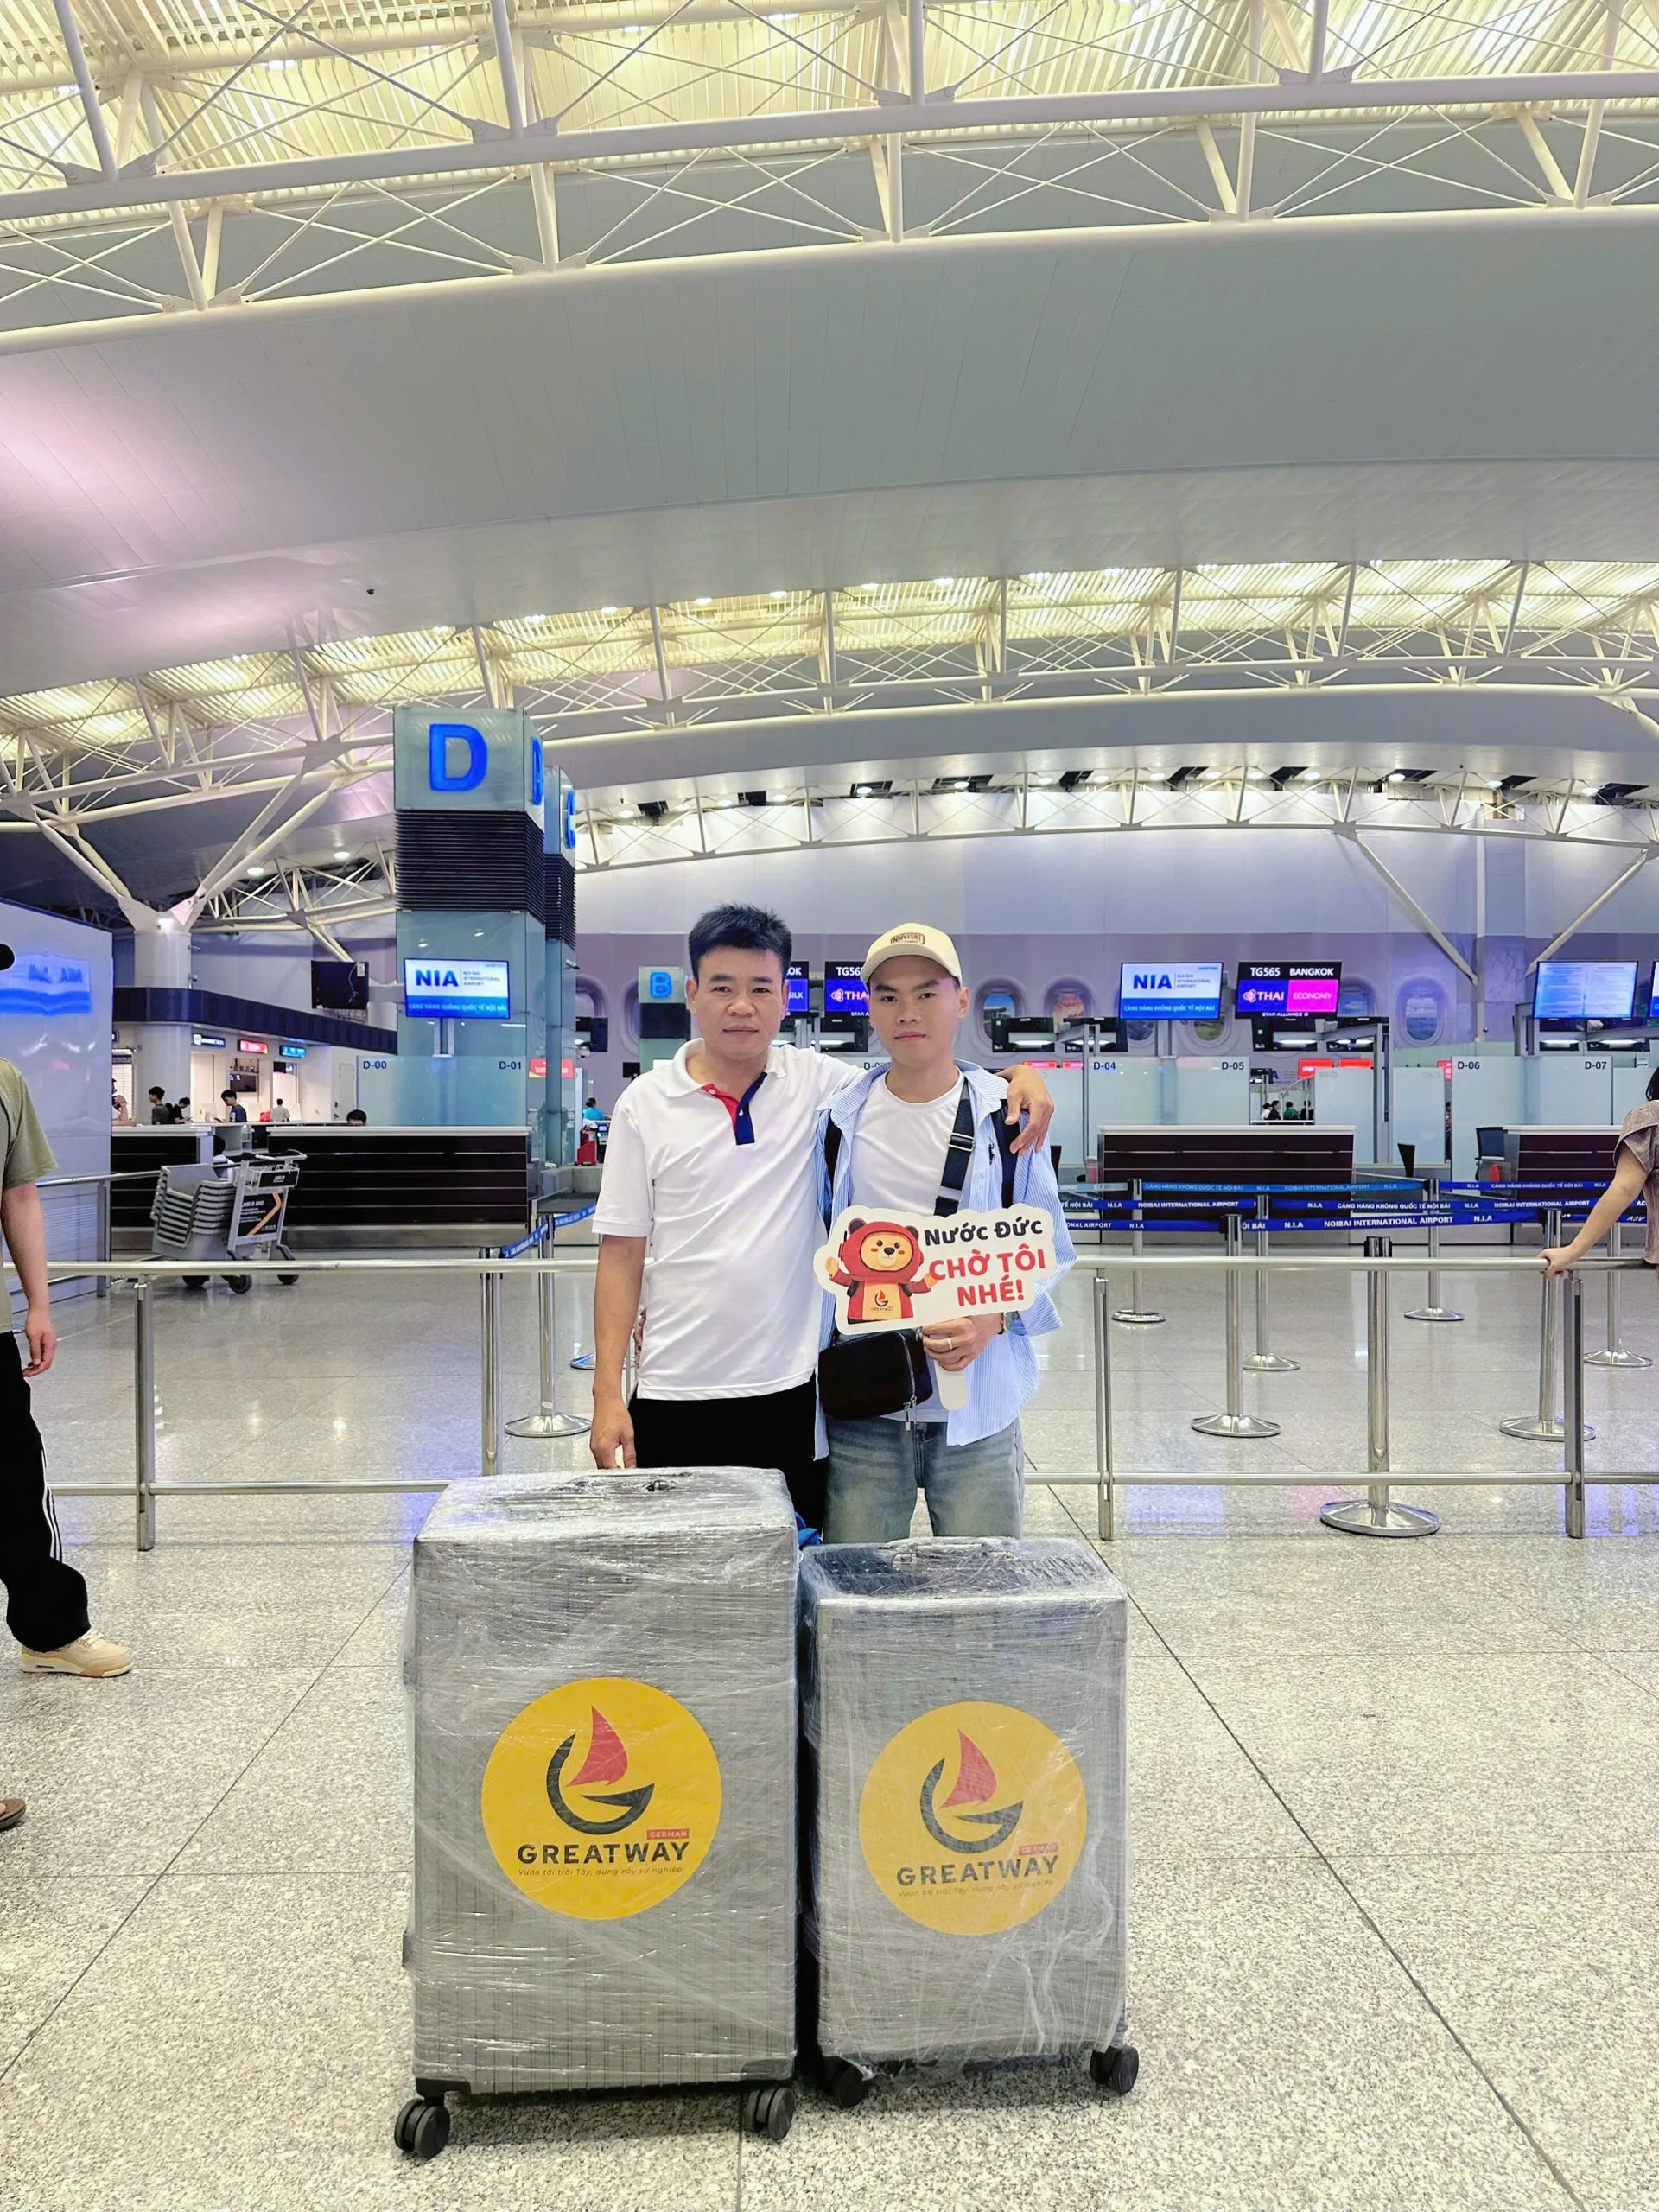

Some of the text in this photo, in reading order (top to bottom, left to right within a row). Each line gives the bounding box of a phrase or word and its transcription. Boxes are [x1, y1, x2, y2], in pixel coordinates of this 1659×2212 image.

[429, 723, 488, 791] D
[416, 969, 459, 987] NIA
[1250, 967, 1334, 976] TG565 BANGKOK
[650, 971, 672, 999] B
[1133, 975, 1172, 989] NIA
[1257, 992, 1284, 1001] THAI
[363, 1060, 387, 1070] D-00
[499, 1060, 522, 1070] D-01
[1093, 1061, 1116, 1071] D-04
[1221, 1061, 1244, 1071] D-05
[1457, 1061, 1480, 1070] D-06
[1585, 1061, 1607, 1070] D-07
[924, 1217, 1043, 1246] Nước Đức
[929, 1243, 1046, 1281] CHỜ TÔI
[957, 1274, 1025, 1306] NHÉ!
[518, 1842, 690, 1864] GREATWAY
[897, 1855, 1059, 1886] GREATWAY
